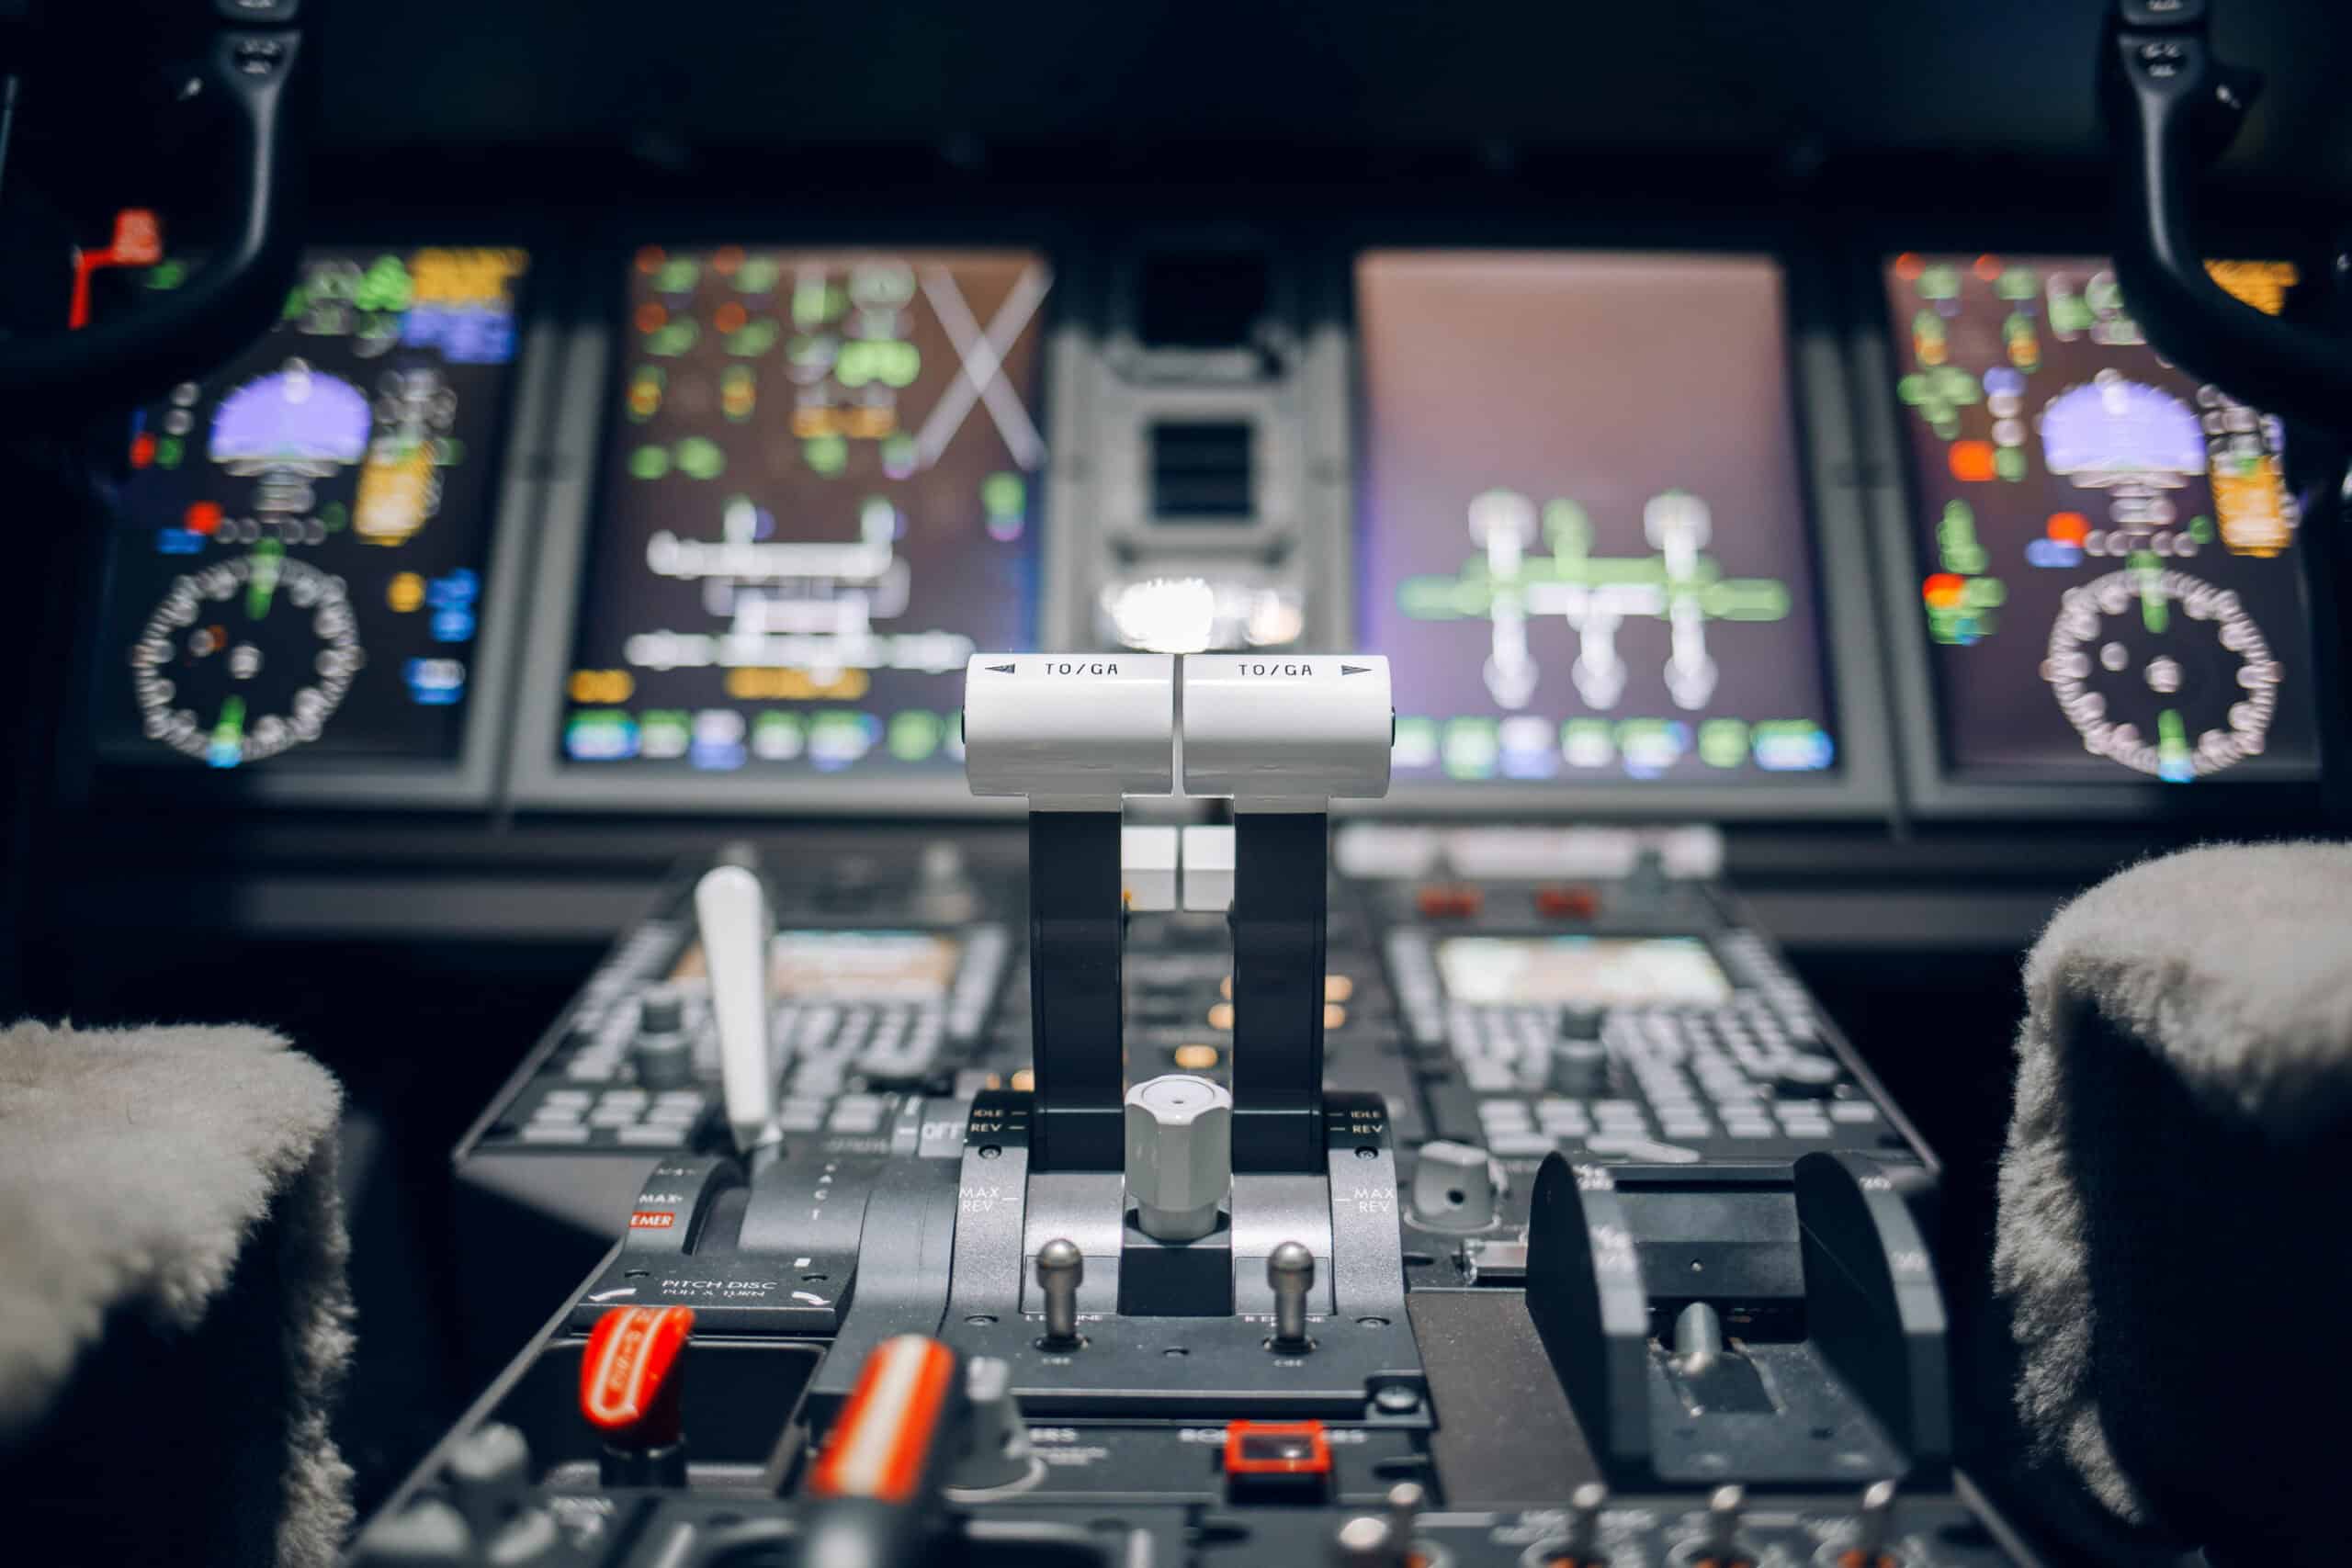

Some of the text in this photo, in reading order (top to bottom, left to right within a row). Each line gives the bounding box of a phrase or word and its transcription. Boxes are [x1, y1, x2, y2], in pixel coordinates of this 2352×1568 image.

[1045, 662, 1119, 676] TO/GA
[1237, 663, 1314, 677] TO/GA
[921, 1121, 964, 1140] OFF
[970, 1122, 1002, 1133] REV
[1351, 1123, 1383, 1134] REV
[958, 1187, 1001, 1199] MAX
[1353, 1187, 1395, 1199] MAX
[962, 1200, 993, 1213] REV
[1359, 1200, 1390, 1213] REV
[629, 1214, 673, 1227] EMER
[662, 1279, 778, 1290] PITCH DISC
